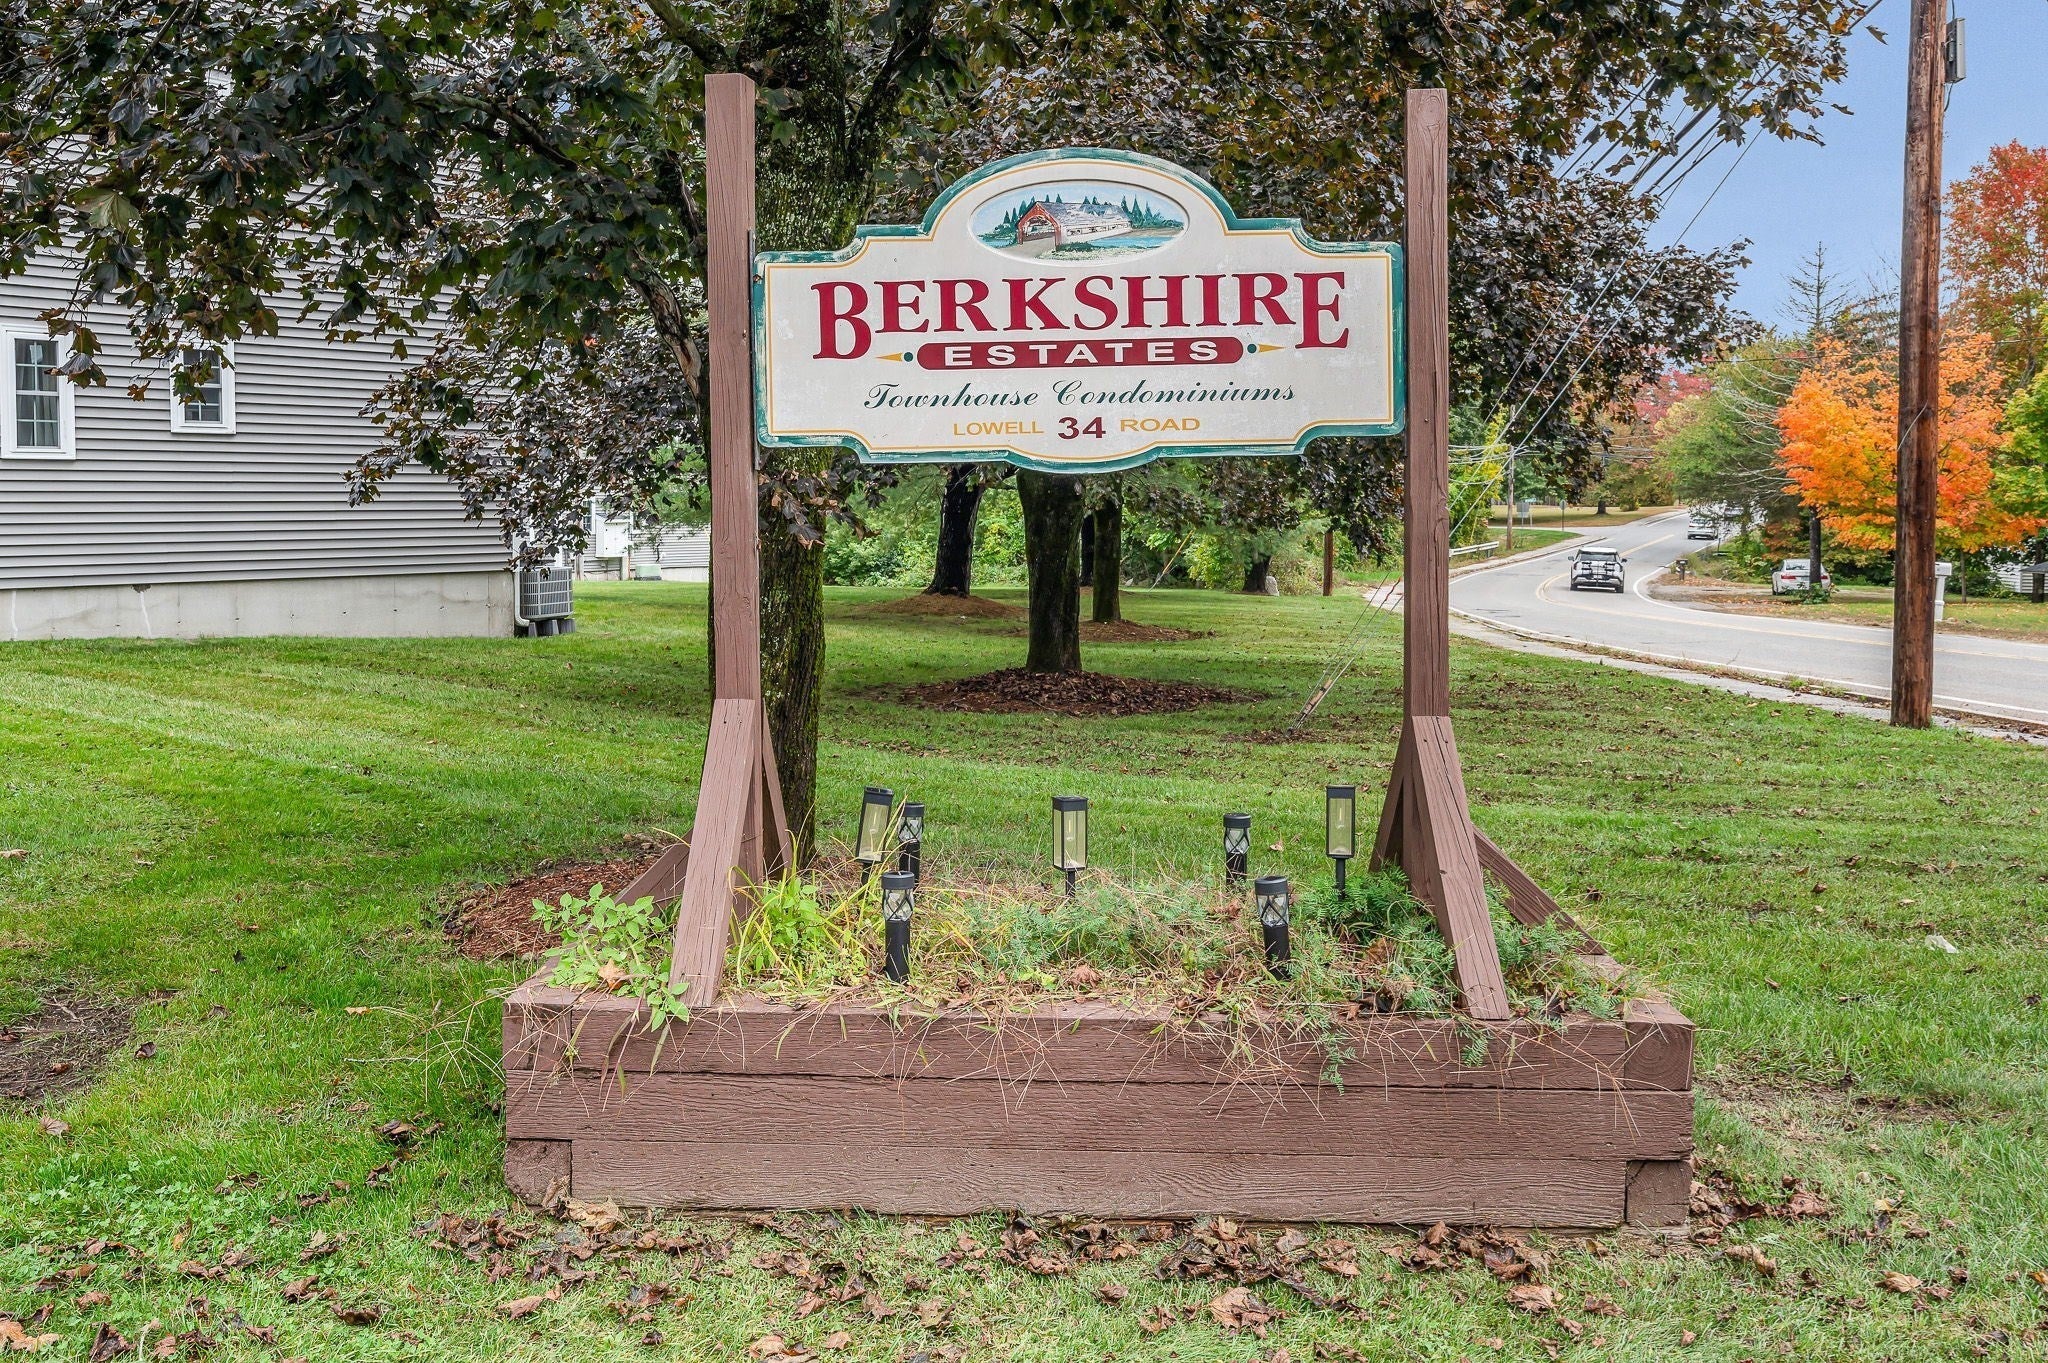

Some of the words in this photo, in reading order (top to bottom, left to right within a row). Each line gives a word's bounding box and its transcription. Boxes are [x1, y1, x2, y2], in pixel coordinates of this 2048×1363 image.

[810, 271, 1349, 360] BERKSHIRE
[945, 340, 1218, 366] ESTATES
[863, 383, 1038, 409] Townhouse
[1052, 379, 1295, 406] Condominiums
[953, 420, 1044, 436] LOWELL
[1056, 415, 1107, 441] 34
[1120, 416, 1201, 433] ROAD
